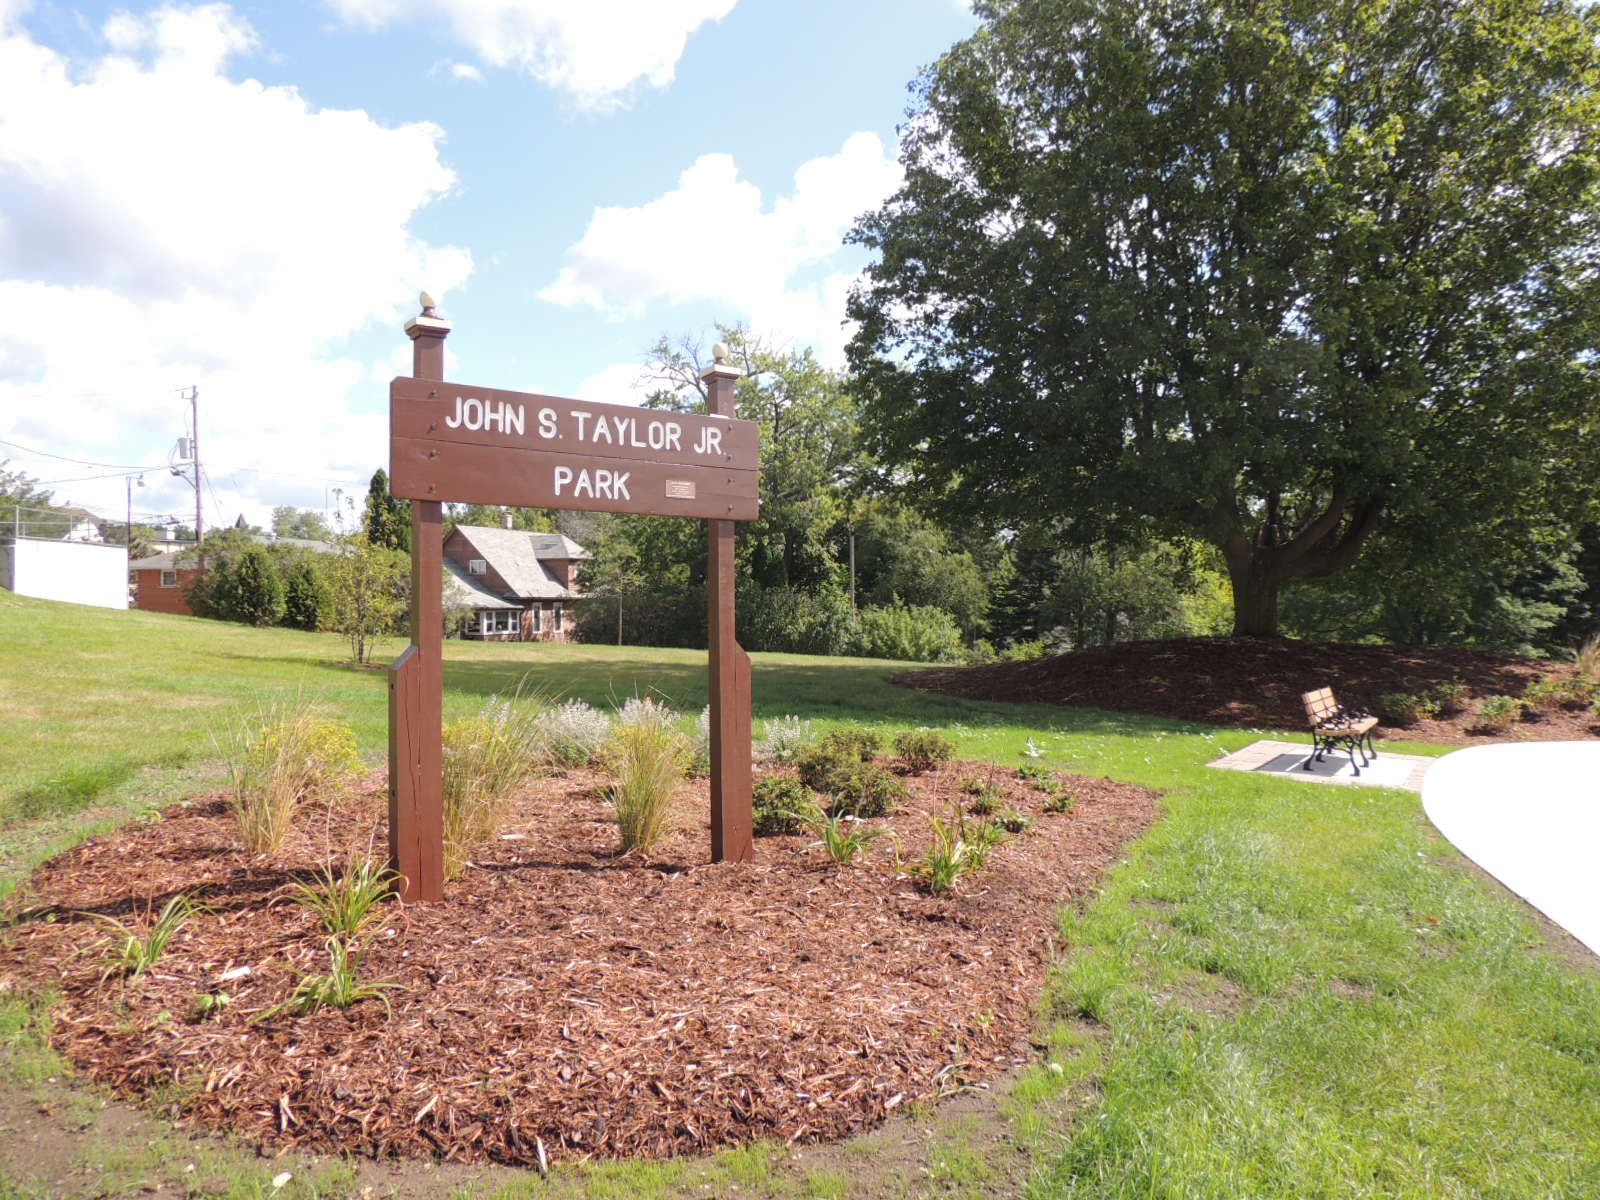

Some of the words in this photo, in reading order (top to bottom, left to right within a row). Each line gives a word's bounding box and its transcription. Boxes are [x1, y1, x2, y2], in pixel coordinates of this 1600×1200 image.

[445, 397, 526, 435] JOHN
[538, 408, 563, 440] S.
[570, 411, 682, 451] TAYLOR
[553, 466, 631, 501] PARK
